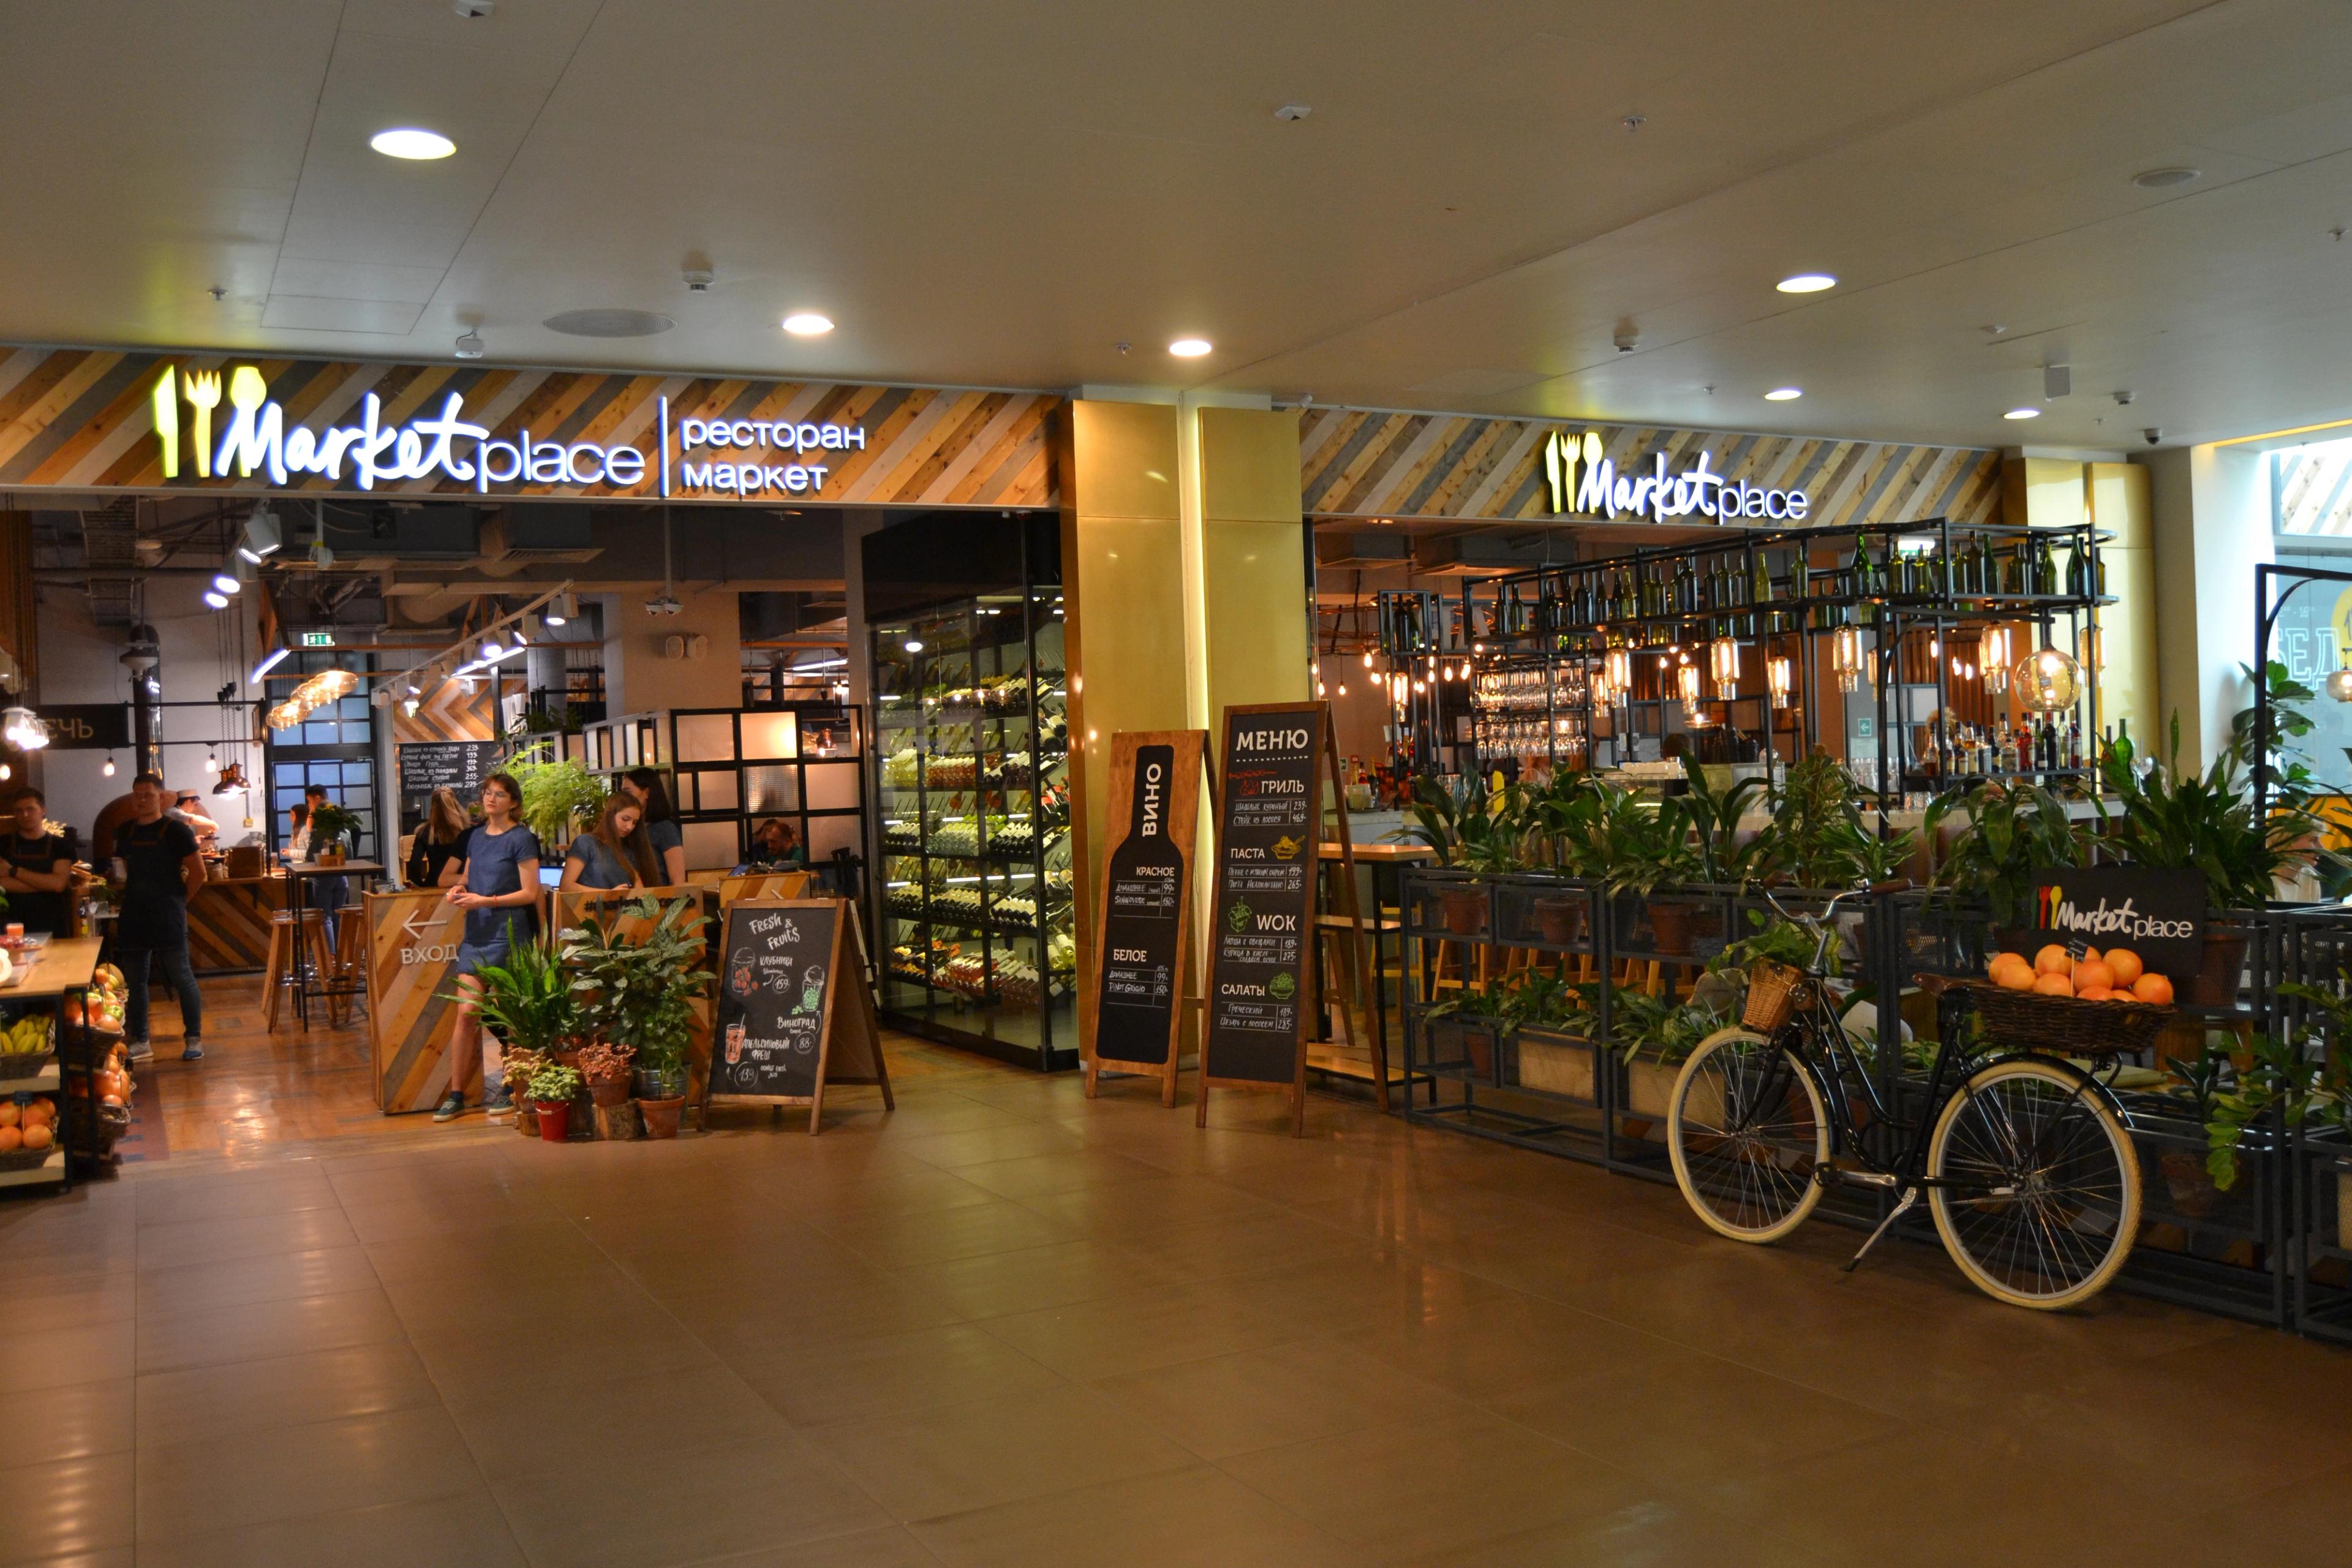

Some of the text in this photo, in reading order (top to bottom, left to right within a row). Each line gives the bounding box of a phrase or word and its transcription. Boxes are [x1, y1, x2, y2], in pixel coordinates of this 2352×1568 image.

[683, 418, 865, 454] ресторан
[683, 462, 828, 495] маркет
[1235, 729, 1308, 752] МЕНЮ
[1261, 780, 1305, 794] ГРИЛЬ
[1142, 763, 1162, 837] ВИНО
[1231, 848, 1265, 859] ПАСТА
[1136, 867, 1175, 876] КРАСНОЕ
[784, 918, 793, 929] &
[1256, 914, 1296, 931] WOK
[400, 943, 459, 965] ВХОД
[1113, 949, 1147, 962] БЕЛОЕ
[760, 956, 793, 967] КЛУБНИКА
[1221, 984, 1265, 997] САЛАТЫ
